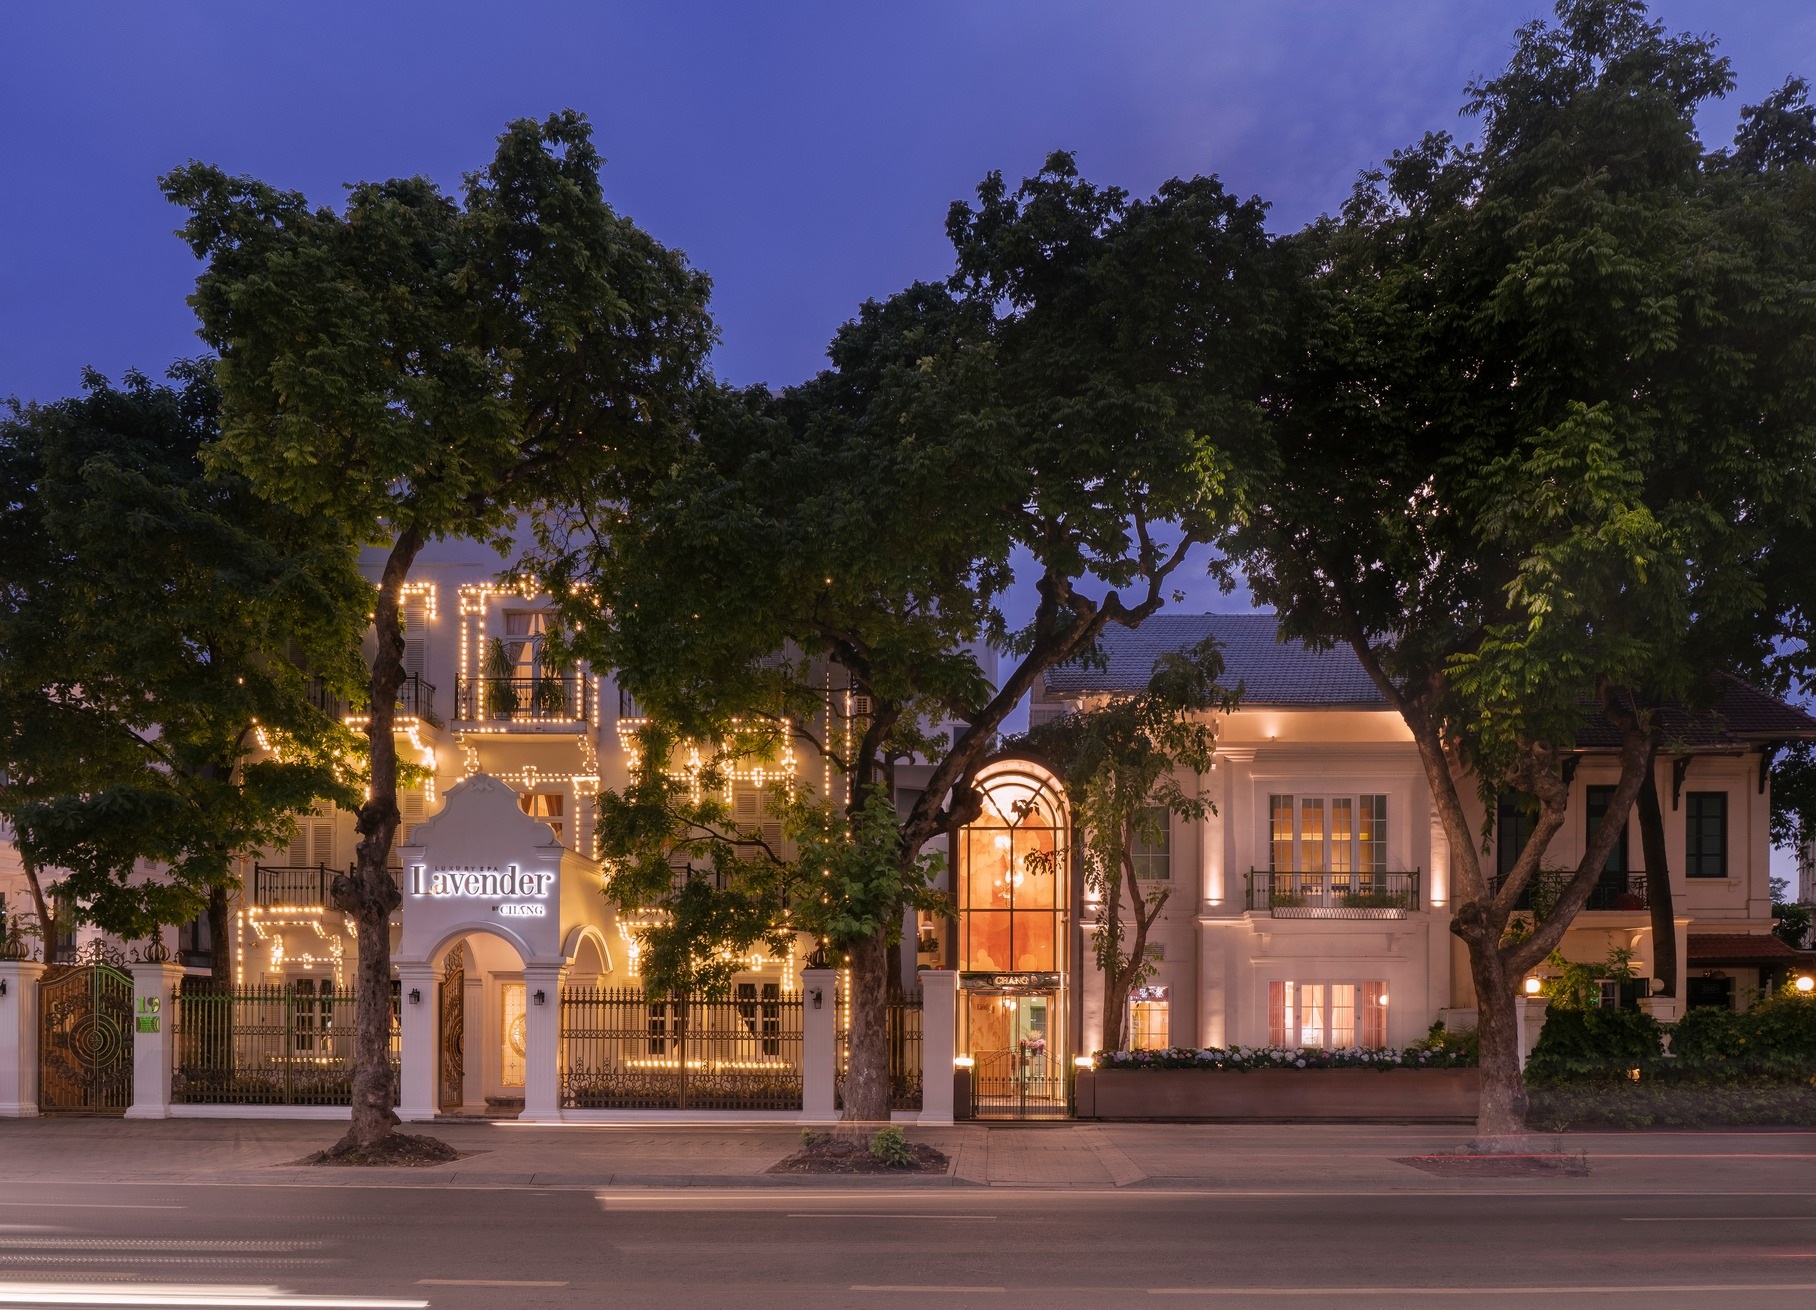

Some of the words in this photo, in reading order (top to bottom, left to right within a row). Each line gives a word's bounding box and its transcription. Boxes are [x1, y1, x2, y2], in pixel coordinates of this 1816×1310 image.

[410, 865, 552, 896] Lavender
[499, 905, 544, 915] CHANG
[994, 976, 1029, 985] CHANG
[137, 996, 161, 1014] 19
